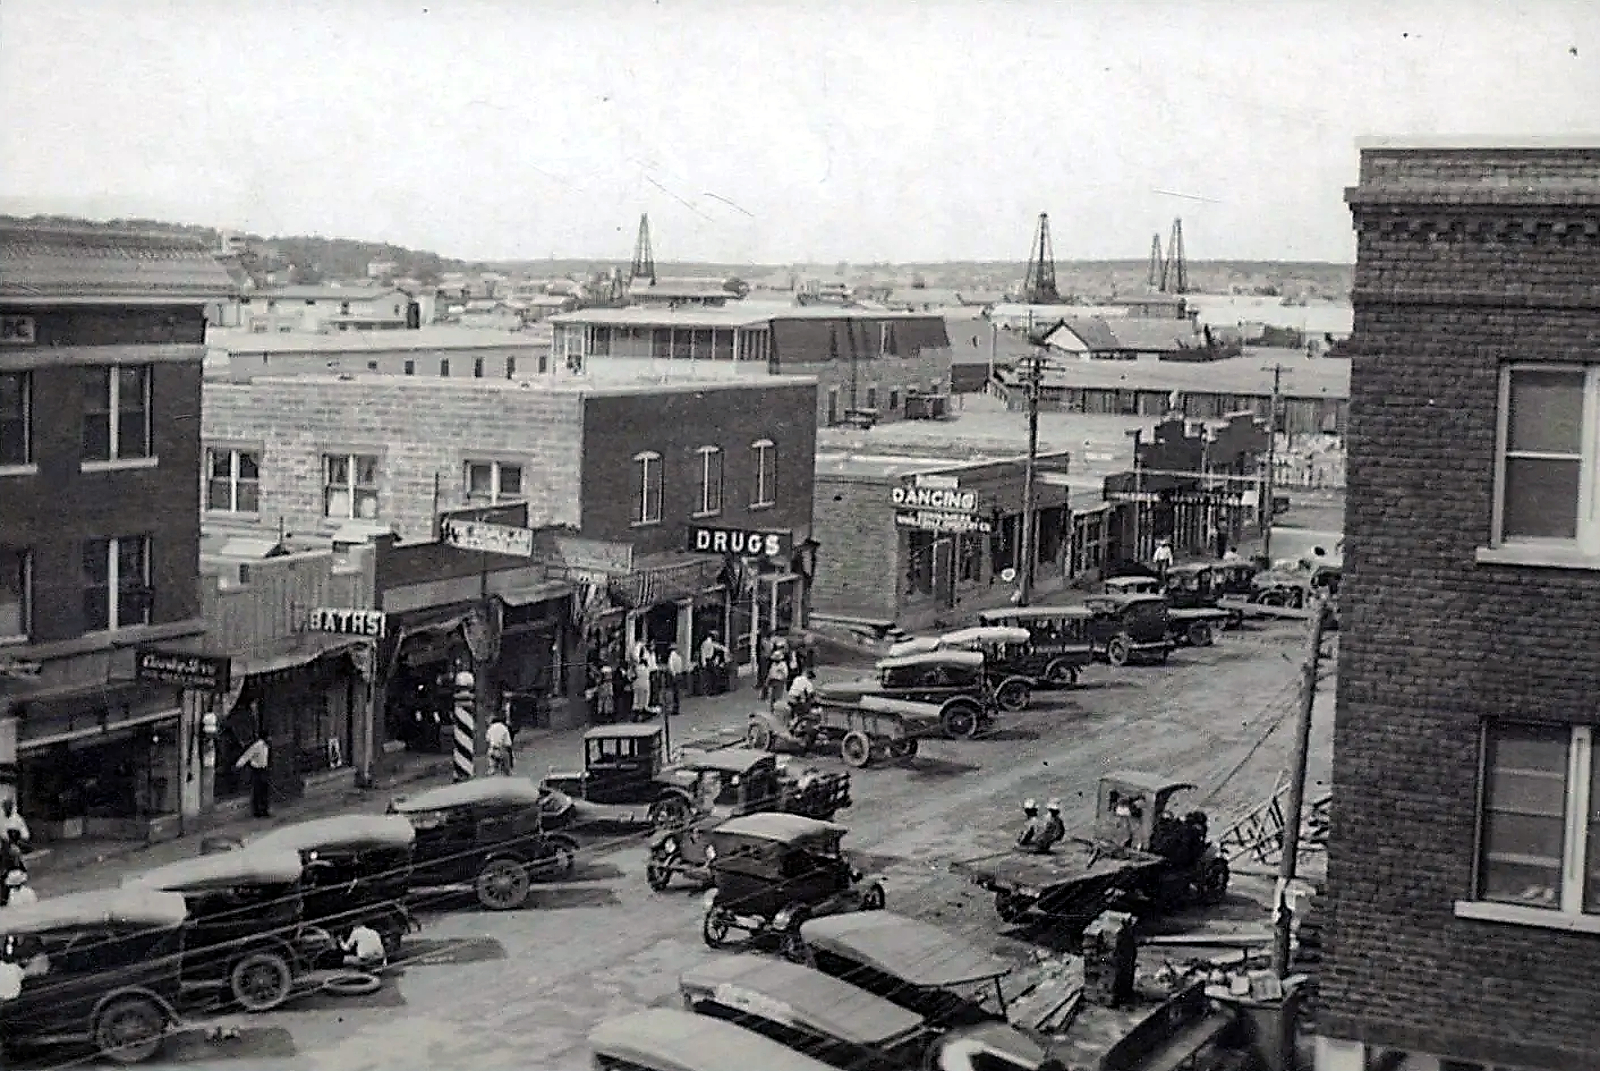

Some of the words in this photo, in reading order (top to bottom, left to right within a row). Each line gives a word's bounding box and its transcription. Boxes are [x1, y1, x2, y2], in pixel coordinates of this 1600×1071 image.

[893, 487, 975, 509] DANCING
[696, 528, 780, 555] DRUGS
[310, 609, 378, 635] BATHS
